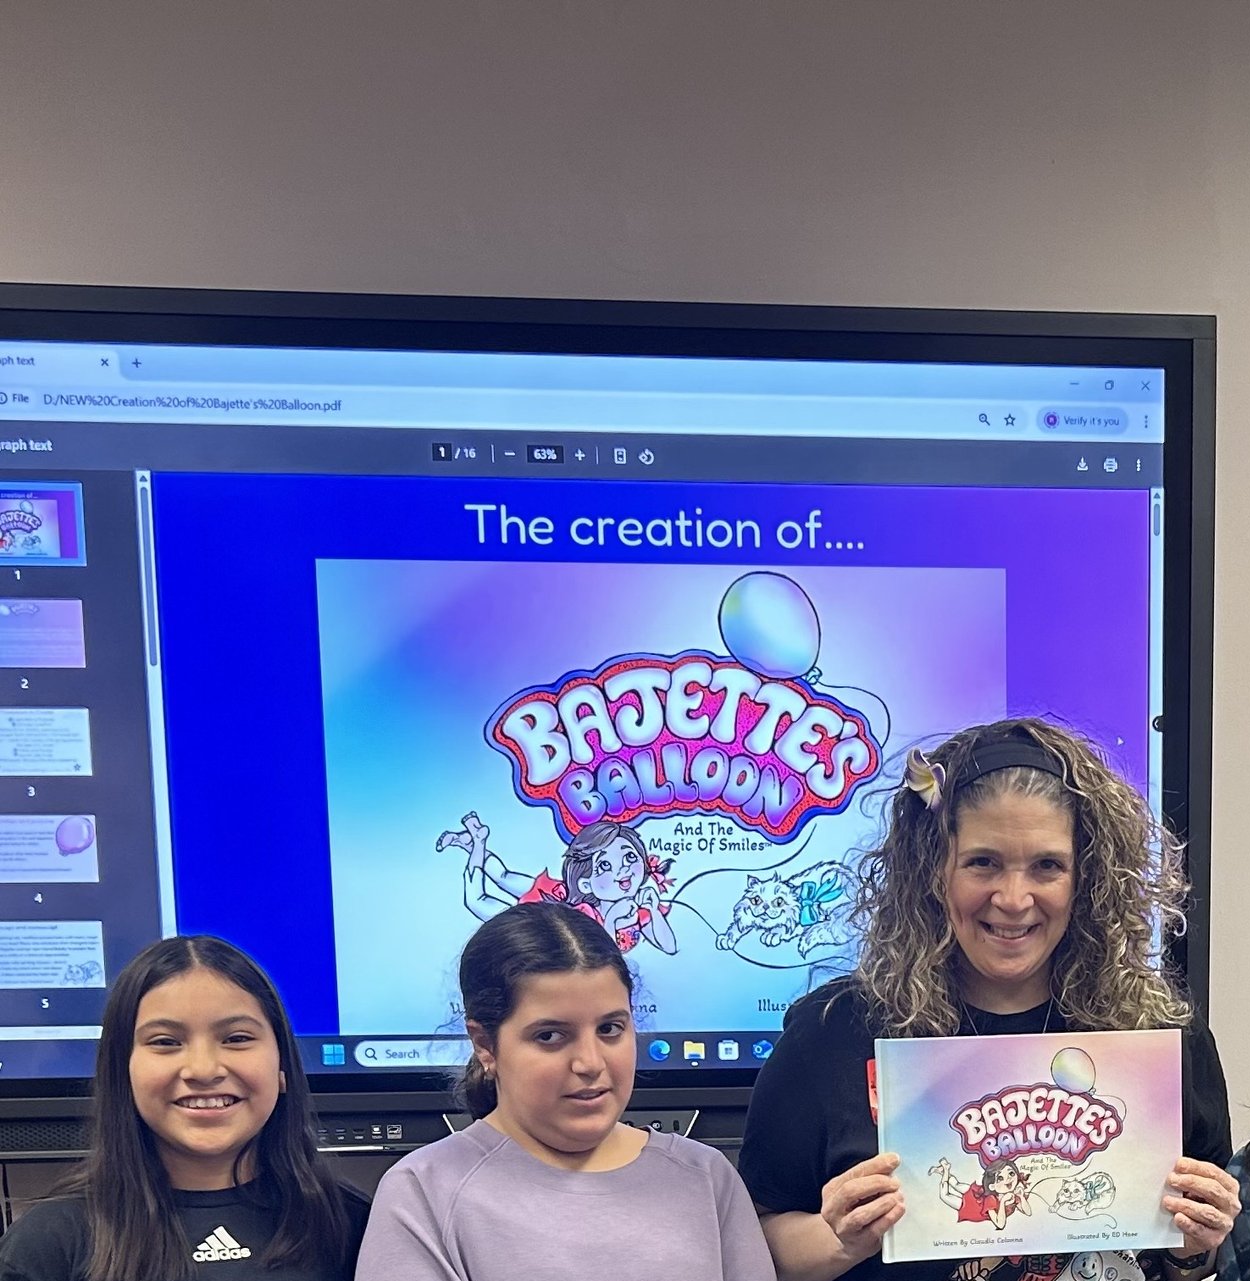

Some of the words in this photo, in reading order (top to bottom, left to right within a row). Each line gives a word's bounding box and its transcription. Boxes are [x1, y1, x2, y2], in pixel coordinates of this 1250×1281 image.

[17, 357, 35, 365] text
[12, 394, 29, 403] File
[1064, 416, 1087, 427] Verify
[1104, 418, 1119, 427] you
[29, 440, 52, 451] text
[439, 446, 445, 458] 1
[464, 448, 476, 458] 16
[533, 448, 557, 459] 63%
[464, 504, 553, 545] The
[570, 508, 760, 549] creation
[776, 510, 864, 549] of....
[15, 570, 21, 580] 1
[21, 679, 29, 689] 2
[503, 662, 870, 800] BAJETTE'S
[559, 743, 806, 826] BALLOON
[28, 787, 35, 797] 3
[674, 822, 702, 836] And
[708, 822, 733, 836] The
[649, 838, 692, 856] Magic
[698, 838, 715, 854] Of
[35, 893, 42, 903] 4
[385, 1049, 420, 1060] Search
[956, 1087, 1118, 1145] BAJETTE'S
[981, 1122, 1088, 1160] BALLOON
[192, 1247, 252, 1262] adidas
